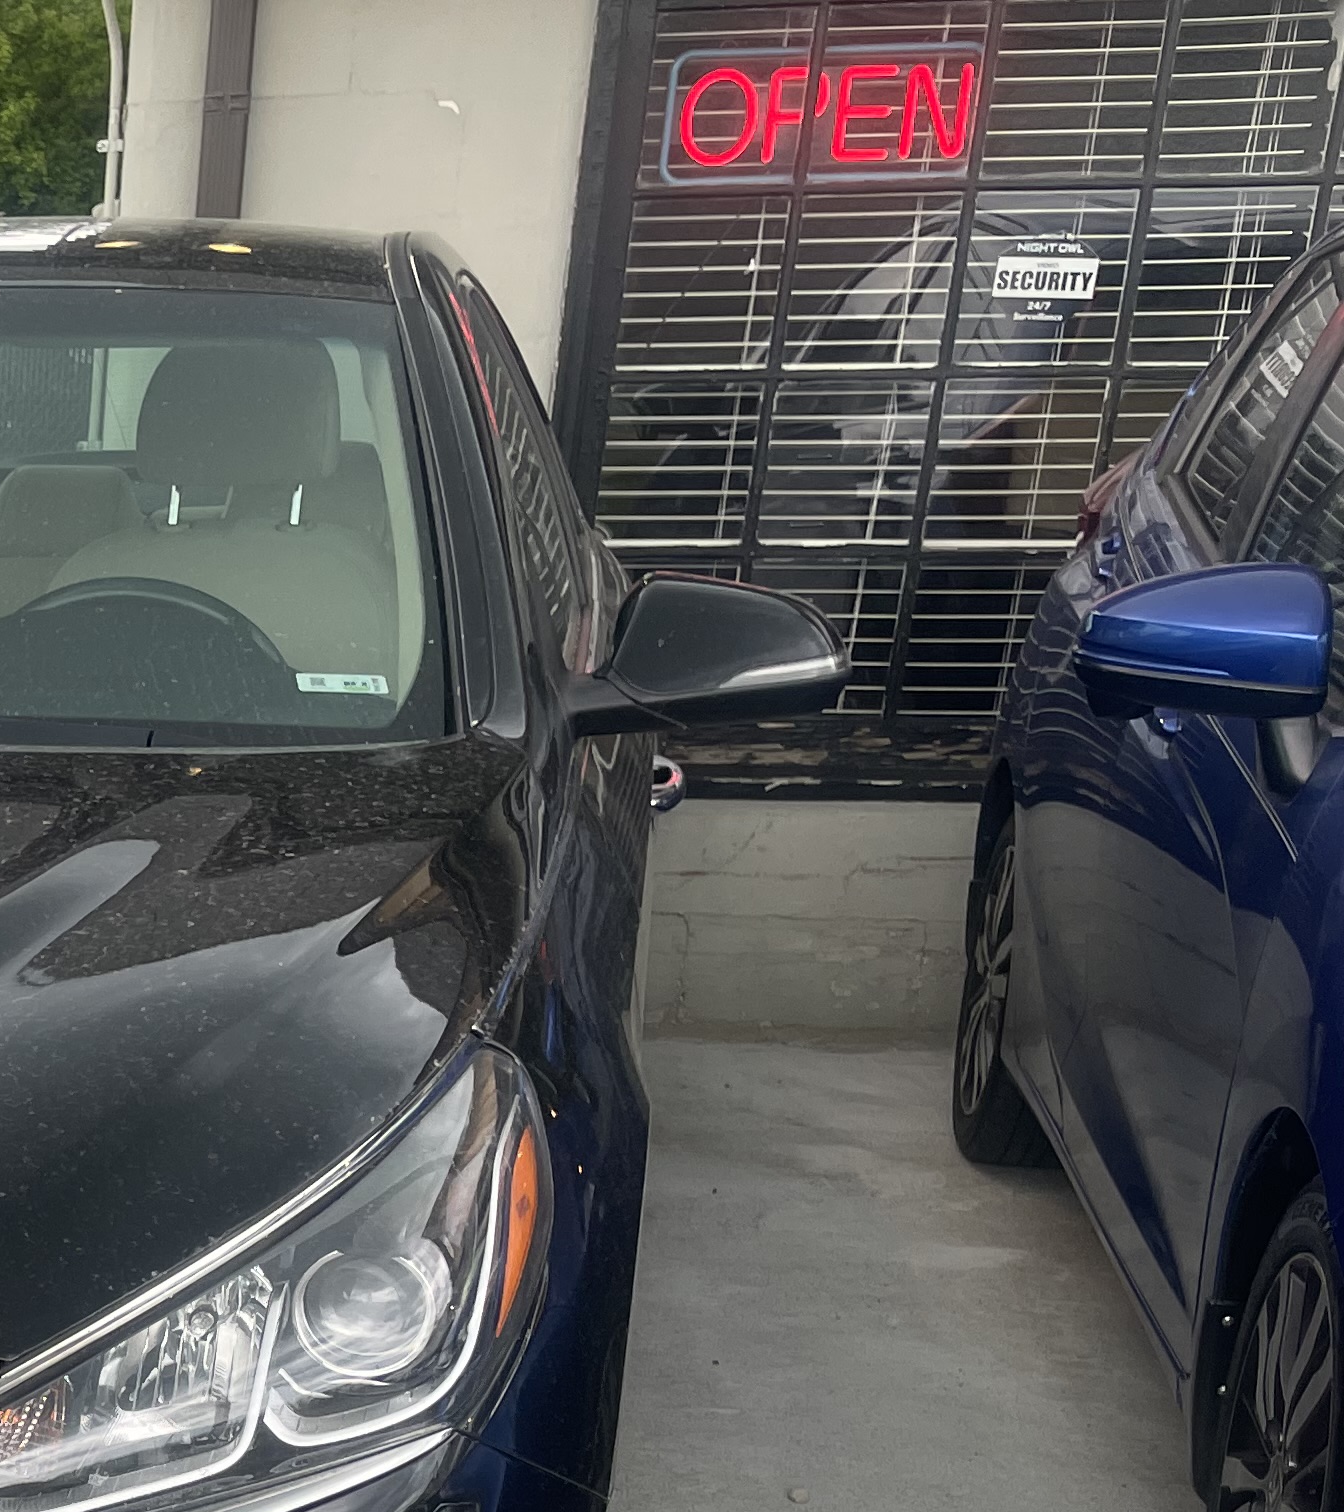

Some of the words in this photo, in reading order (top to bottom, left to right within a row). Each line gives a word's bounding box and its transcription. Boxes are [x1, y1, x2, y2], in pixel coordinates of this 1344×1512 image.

[680, 63, 974, 166] OPEN
[1017, 242, 1058, 253] NIGHT
[1058, 243, 1085, 254] OWL
[997, 270, 1093, 292] SECURITY
[1027, 301, 1052, 310] 24/7
